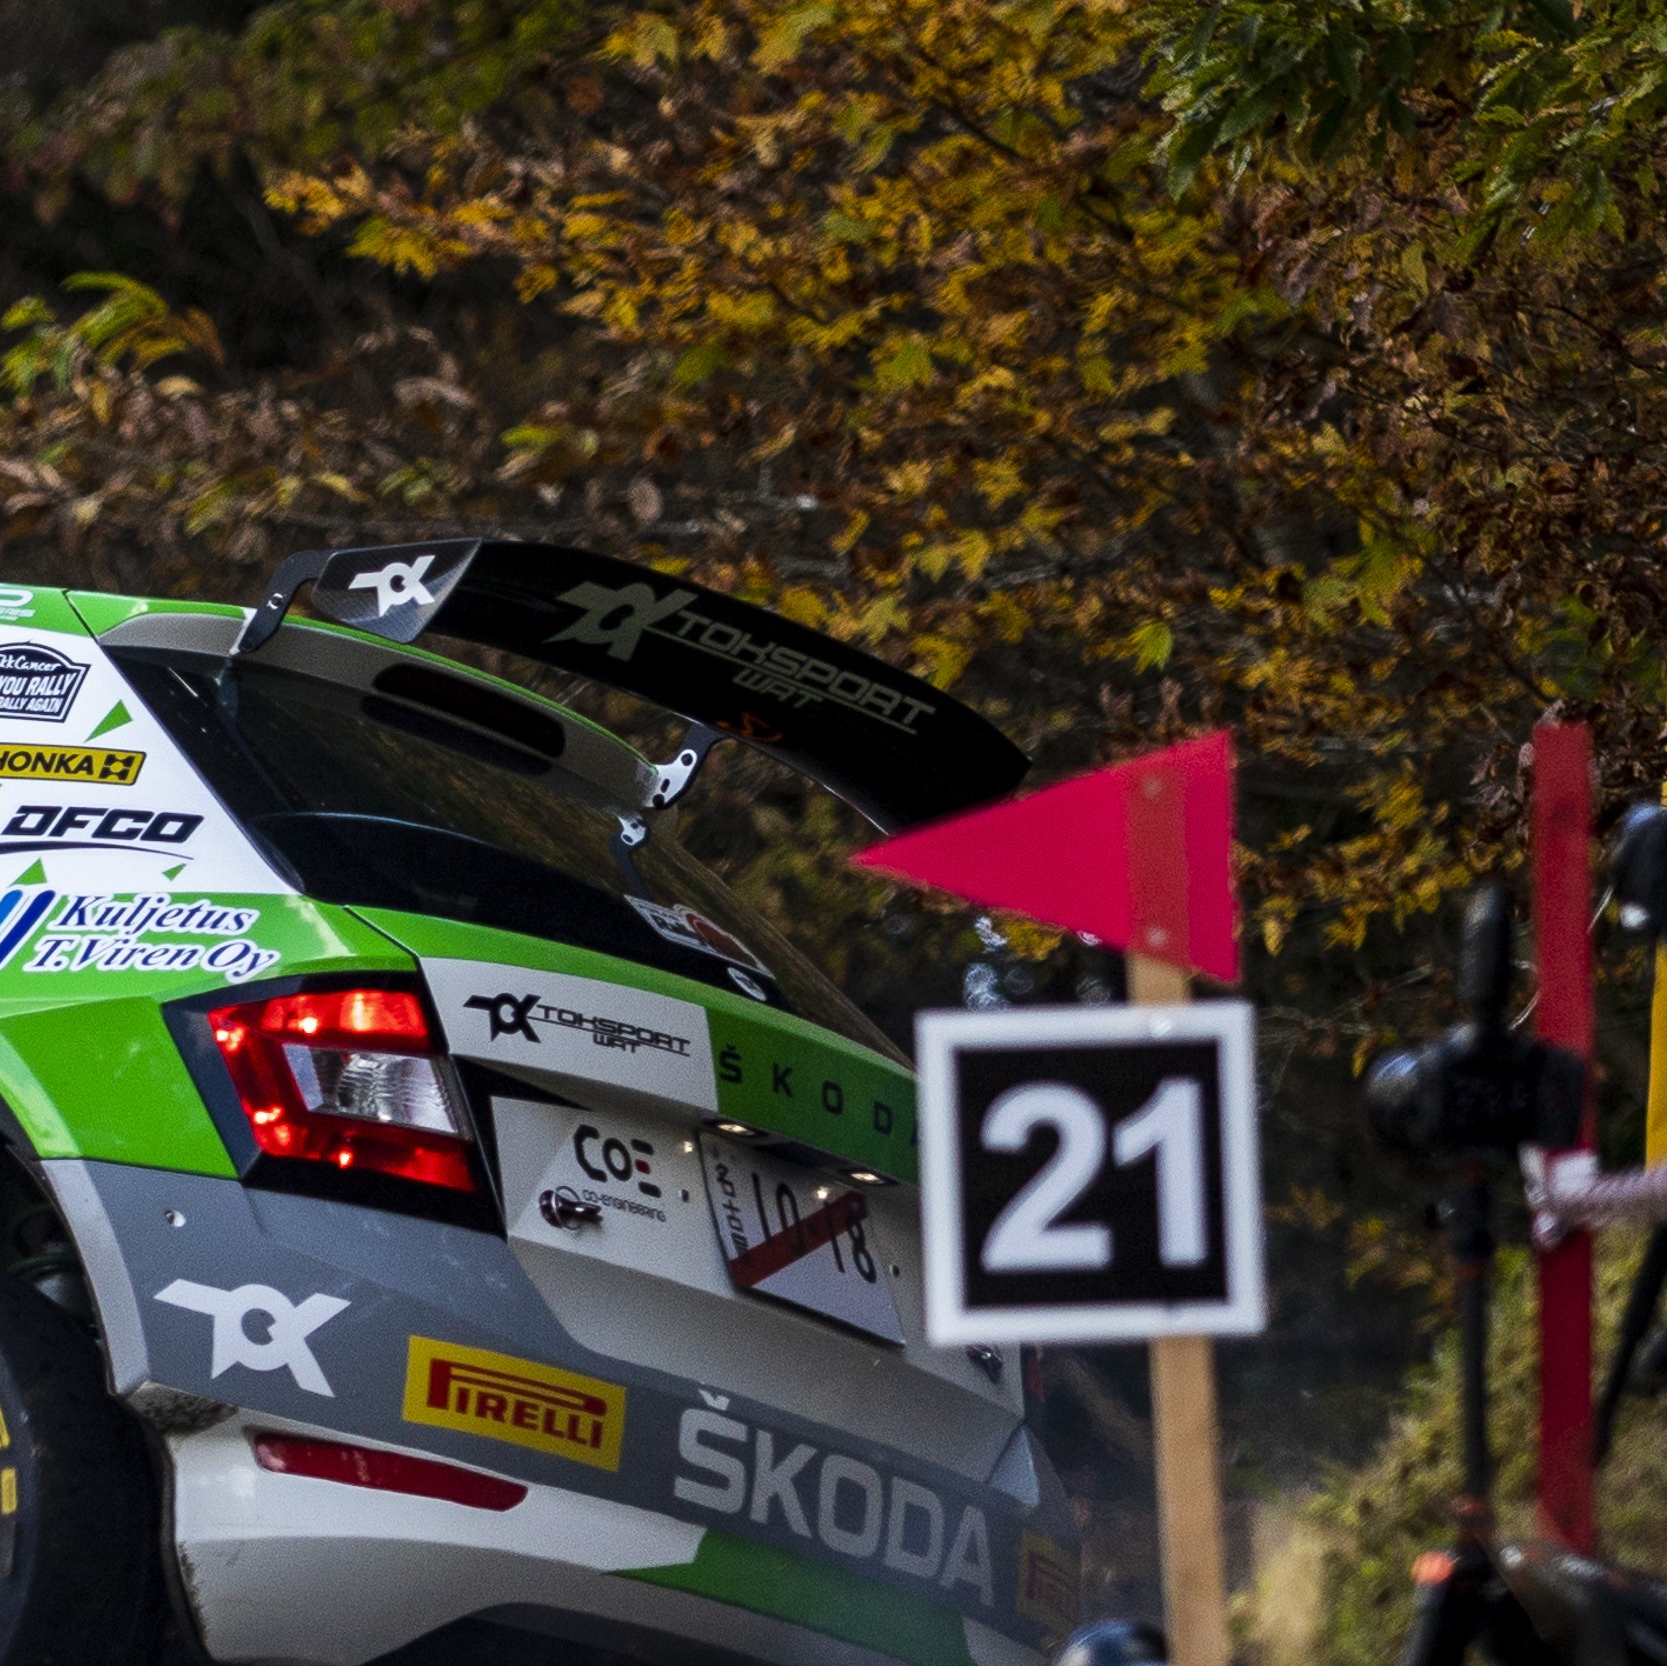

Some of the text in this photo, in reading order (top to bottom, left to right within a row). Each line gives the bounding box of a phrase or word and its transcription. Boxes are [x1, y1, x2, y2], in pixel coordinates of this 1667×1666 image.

[25, 672, 77, 697] RALLY
[677, 609, 935, 725] TOKSPORT
[25, 698, 64, 714] AGAIN
[1, 805, 204, 843] DFCO
[58, 895, 253, 934] Kuljetus
[201, 938, 277, 978] Oy
[537, 1004, 691, 1052] TOKSPORT
[719, 1043, 917, 1146] ŠKOD
[979, 1076, 1209, 1273] 21
[426, 1357, 608, 1449] PIRELLI
[673, 1388, 994, 1608] ŠKODA
